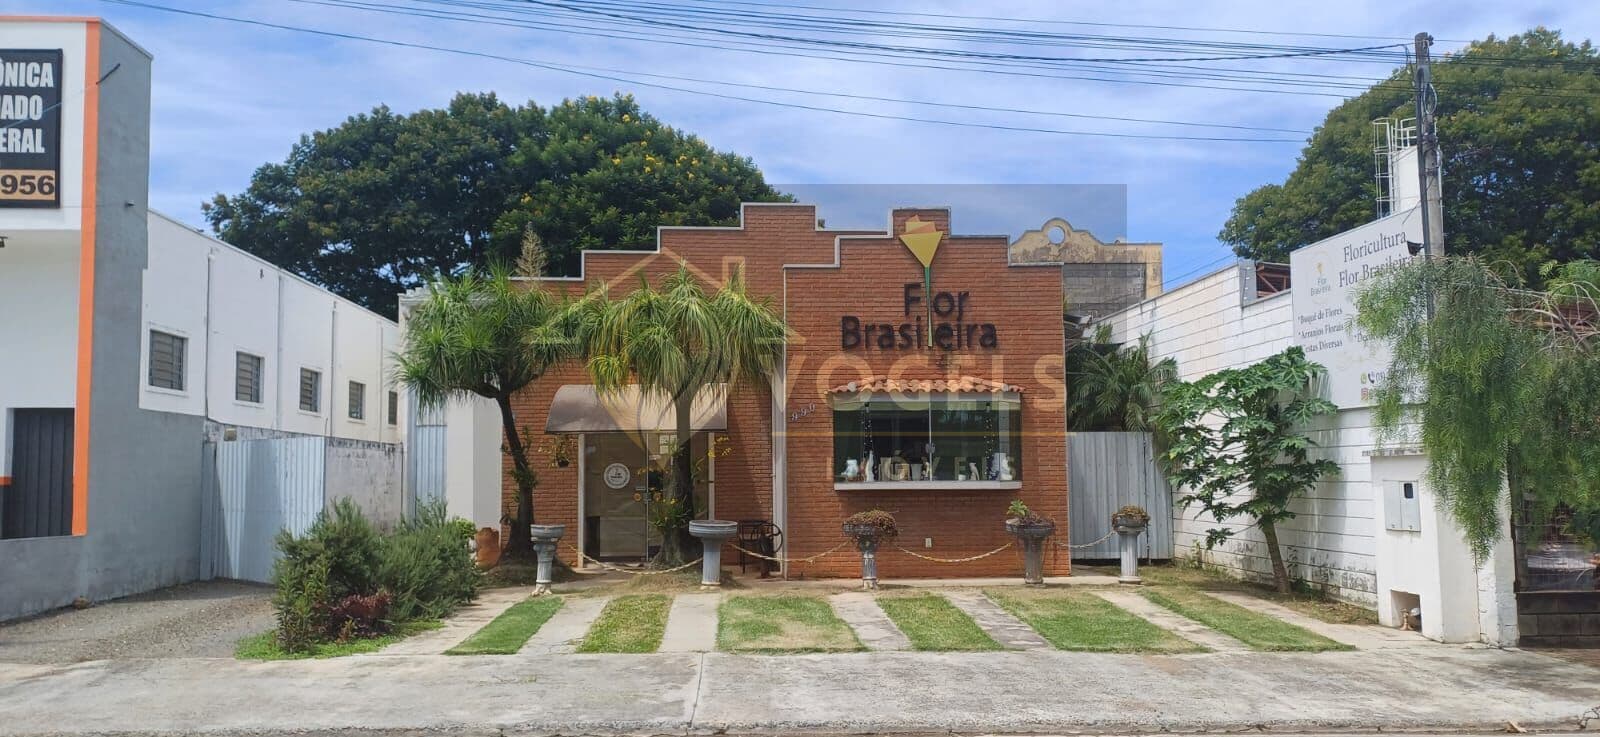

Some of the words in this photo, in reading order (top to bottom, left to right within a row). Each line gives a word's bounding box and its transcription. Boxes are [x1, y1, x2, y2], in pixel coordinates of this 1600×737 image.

[0, 58, 54, 88] NICA
[0, 94, 44, 121] ADO
[1343, 231, 1407, 263] Floricultura
[1339, 269, 1360, 288] Flor
[903, 283, 969, 321] Flor
[841, 315, 998, 352] Brasileira
